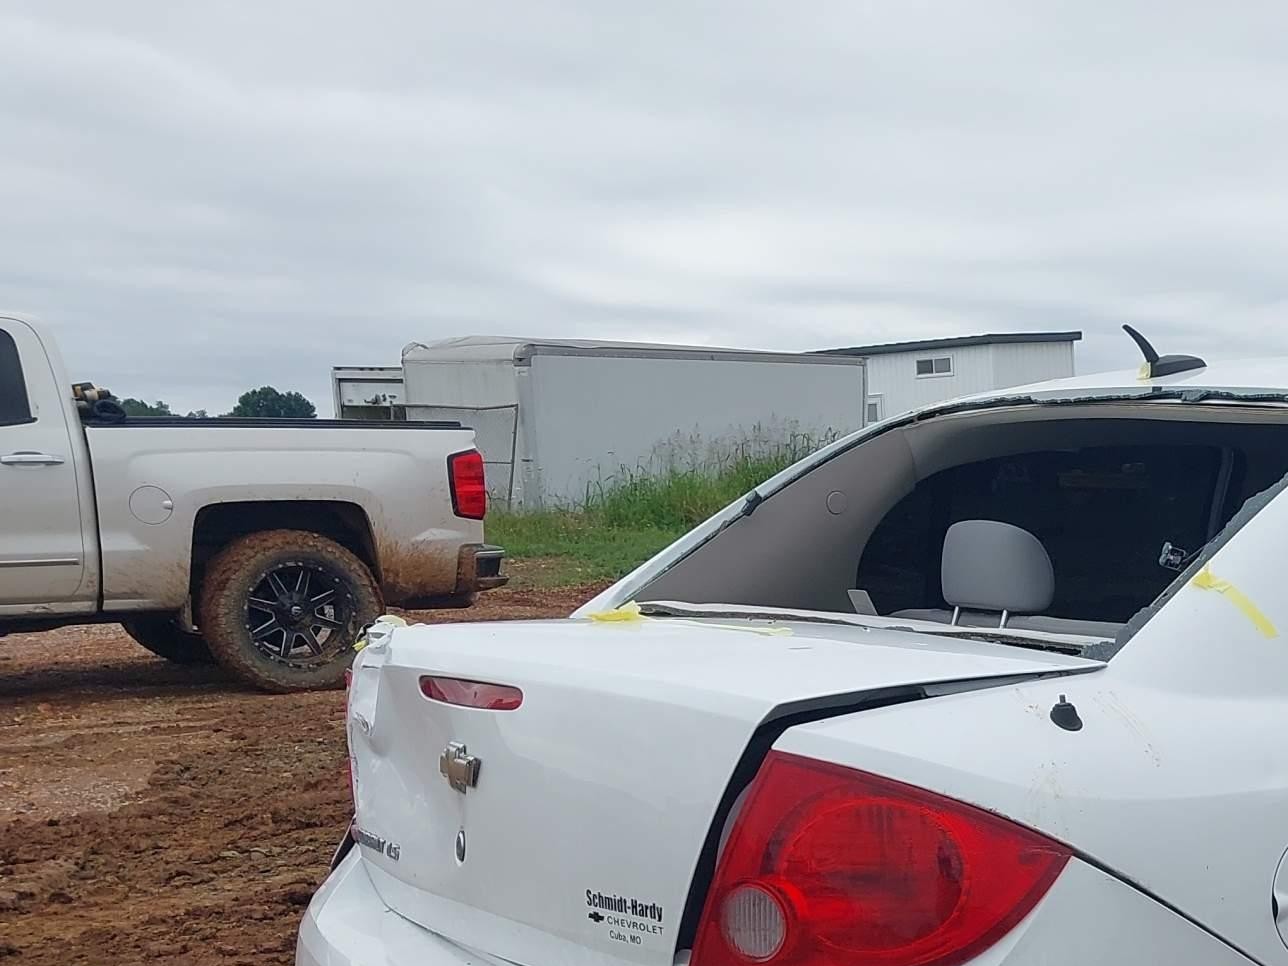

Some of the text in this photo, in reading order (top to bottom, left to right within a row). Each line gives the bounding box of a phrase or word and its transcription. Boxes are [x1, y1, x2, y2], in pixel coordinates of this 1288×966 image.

[586, 888, 663, 922] Schmidt-Hardy
[606, 915, 664, 936] CHEVROLET
[609, 930, 642, 945] Cuba, MO
